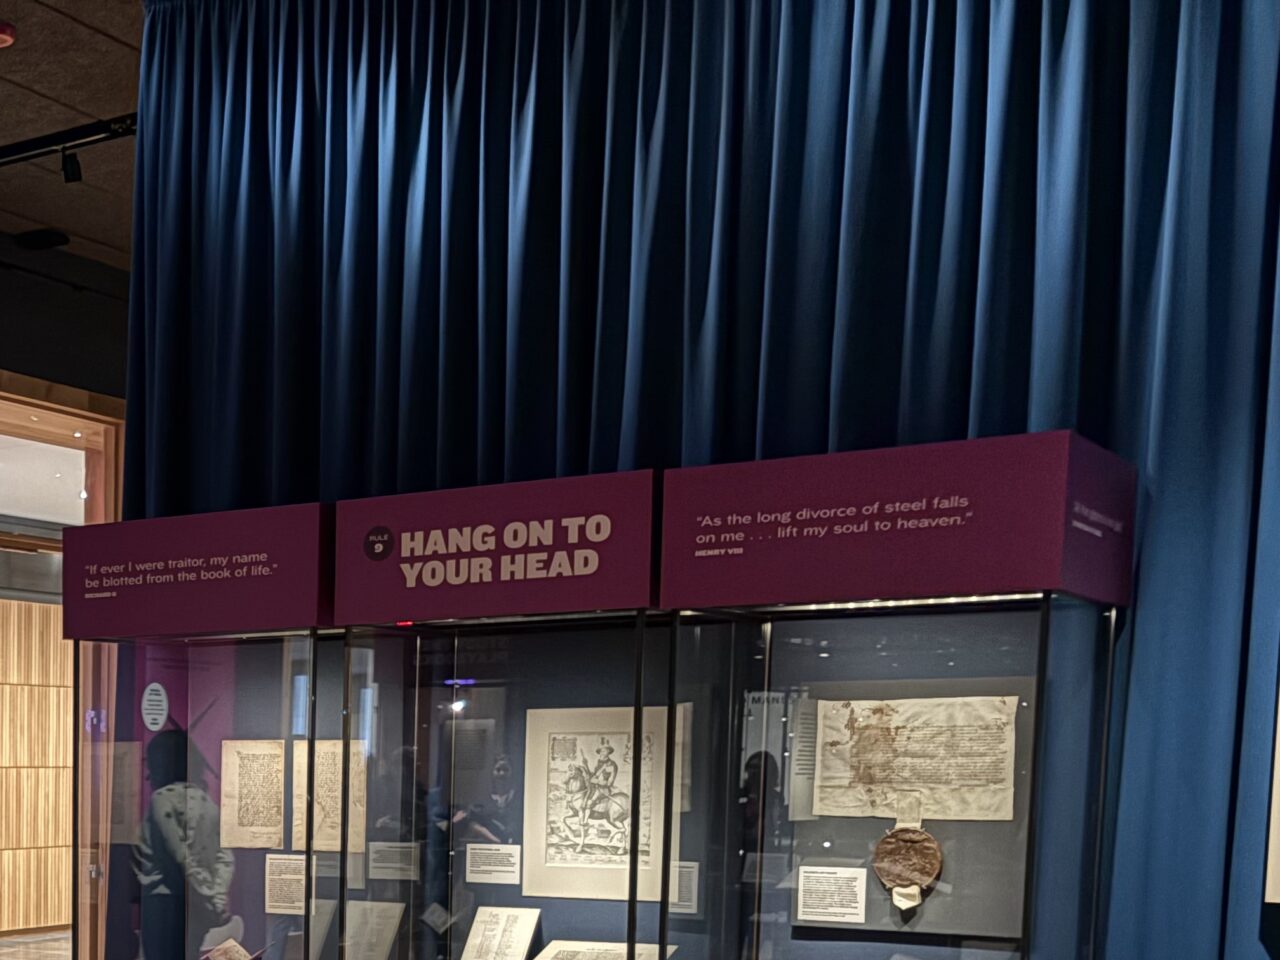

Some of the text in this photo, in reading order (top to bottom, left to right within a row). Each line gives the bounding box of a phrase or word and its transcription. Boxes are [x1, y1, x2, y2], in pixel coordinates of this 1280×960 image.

[727, 514, 752, 526] the
[757, 512, 791, 525] long
[796, 506, 856, 521] divorce
[862, 502, 881, 515] of
[884, 499, 927, 514] steel
[932, 496, 969, 510] falls
[369, 534, 389, 542] RULE
[400, 514, 612, 558] HANG ON TO
[696, 534, 716, 544] on
[720, 531, 745, 542] me
[777, 526, 798, 538] lift
[804, 526, 828, 538] my
[833, 520, 868, 534] soul
[874, 520, 892, 532] to
[374, 543, 384, 553] 9
[100, 565, 125, 574] ever
[136, 561, 164, 572] were
[169, 557, 207, 569] traitor,
[210, 556, 228, 566] my
[232, 553, 268, 564] name
[400, 549, 599, 588] YOUR HEAD
[86, 579, 99, 588] be
[103, 575, 142, 587] blotted
[146, 572, 174, 584] from
[178, 571, 196, 582] the
[201, 568, 232, 580] book
[234, 566, 248, 577] of
